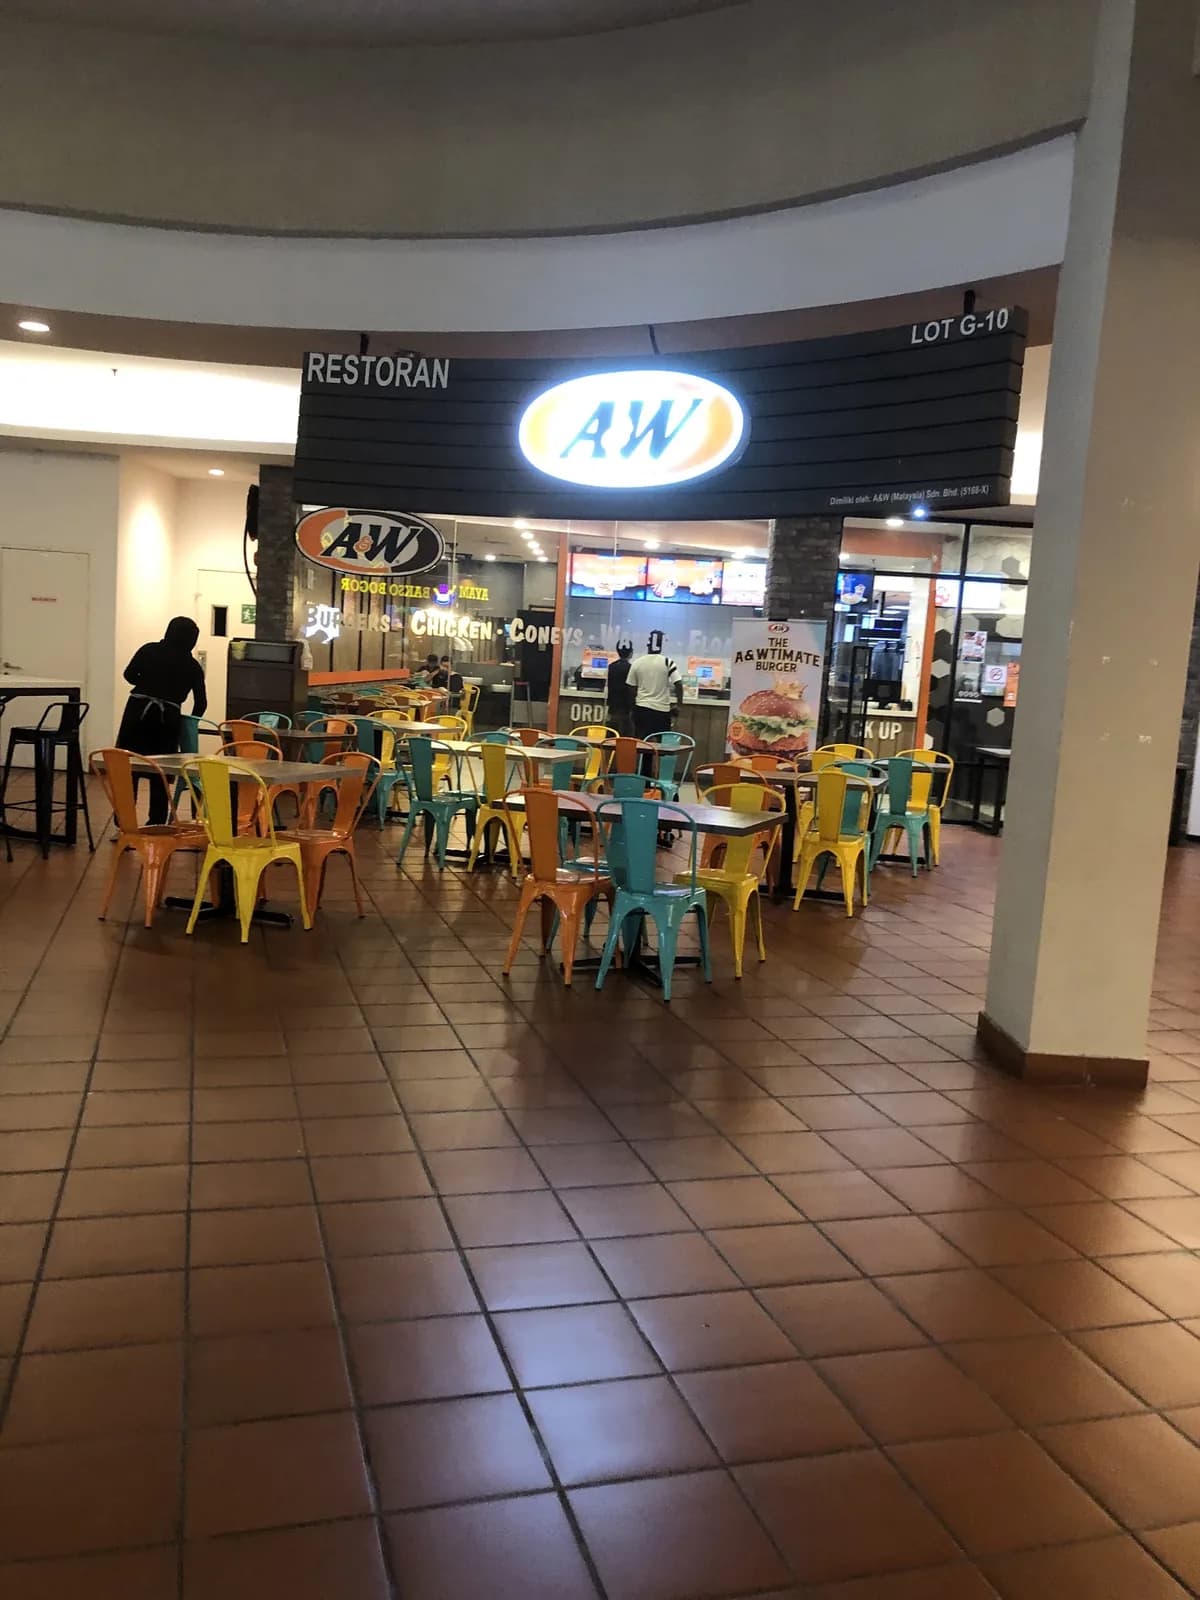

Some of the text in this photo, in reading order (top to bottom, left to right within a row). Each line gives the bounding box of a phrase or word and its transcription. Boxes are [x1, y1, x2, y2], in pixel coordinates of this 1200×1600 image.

[911, 308, 1009, 344] LOT G-10
[307, 352, 450, 389] RESTORAN
[872, 493, 890, 503] A&W
[320, 522, 424, 563] A&W
[768, 637, 789, 647] THE
[735, 648, 821, 668] A&WTIMATE
[755, 661, 797, 673] BURGER
[879, 721, 902, 740] UP
